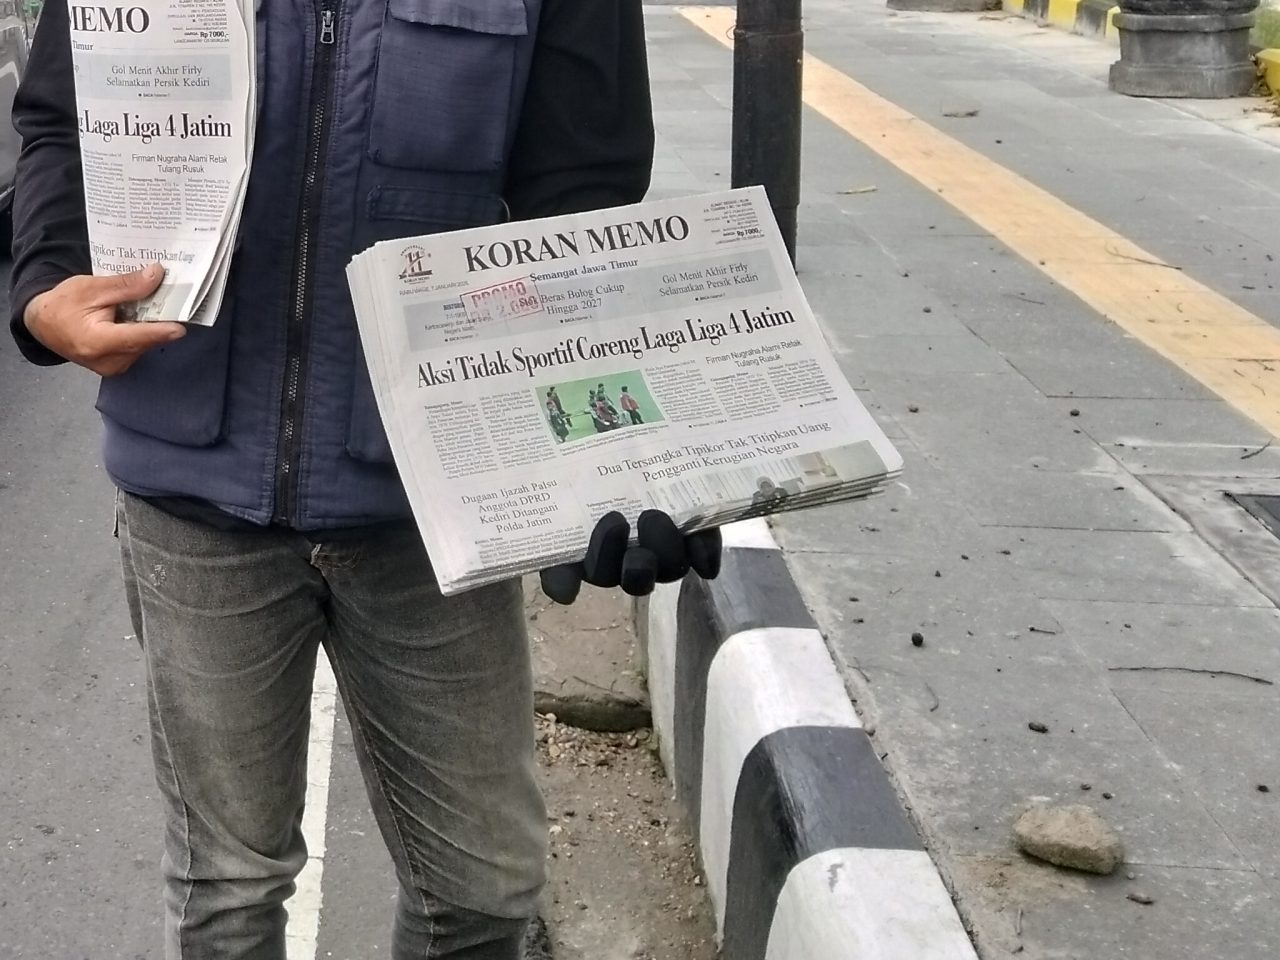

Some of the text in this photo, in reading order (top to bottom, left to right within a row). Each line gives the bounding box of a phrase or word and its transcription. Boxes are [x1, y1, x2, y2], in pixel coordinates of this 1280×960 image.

[111, 64, 202, 76] Gol Menit Akhir Firly
[106, 76, 210, 87] Selamatkan Persik Kediri
[84, 110, 232, 144] Laga Liga 4 Jatim
[131, 153, 227, 165] Firman Nugraha Alami Retak
[157, 164, 205, 174] Tulang Rusuk
[462, 230, 581, 272] KORAN
[584, 215, 690, 254] MEMO
[96, 257, 137, 273] Kerugian
[115, 247, 136, 259] Tak
[138, 248, 178, 263] Titipkan
[529, 258, 639, 283] Semangat Jawa Timur
[662, 263, 748, 285] Gol Menit Akhir Firly
[541, 292, 565, 304] Beras
[568, 286, 594, 300] Bulog
[595, 282, 625, 295] Cukup
[659, 281, 705, 297] Selamatkan
[706, 278, 732, 290] Persik
[733, 273, 759, 285] Kediri
[547, 298, 602, 315] Hingga 2027
[418, 306, 796, 388] Aksi Tidak Sportif Coreng Laga Liga 4 Jatim
[706, 339, 802, 365] Firman Nugraha Alami Retak
[735, 353, 781, 368] Tulang Rusuk
[597, 421, 831, 477] Dua Tersangka Tipikor Tak Titipkan Uang
[642, 440, 800, 483] Pengganti Kerugian Negara
[461, 478, 558, 505] Dugaan Ijazah Palsu
[478, 492, 551, 515] Anggota DPRD
[479, 504, 559, 525] Kediri Ditangani
[496, 517, 553, 534] Polda Jatim
